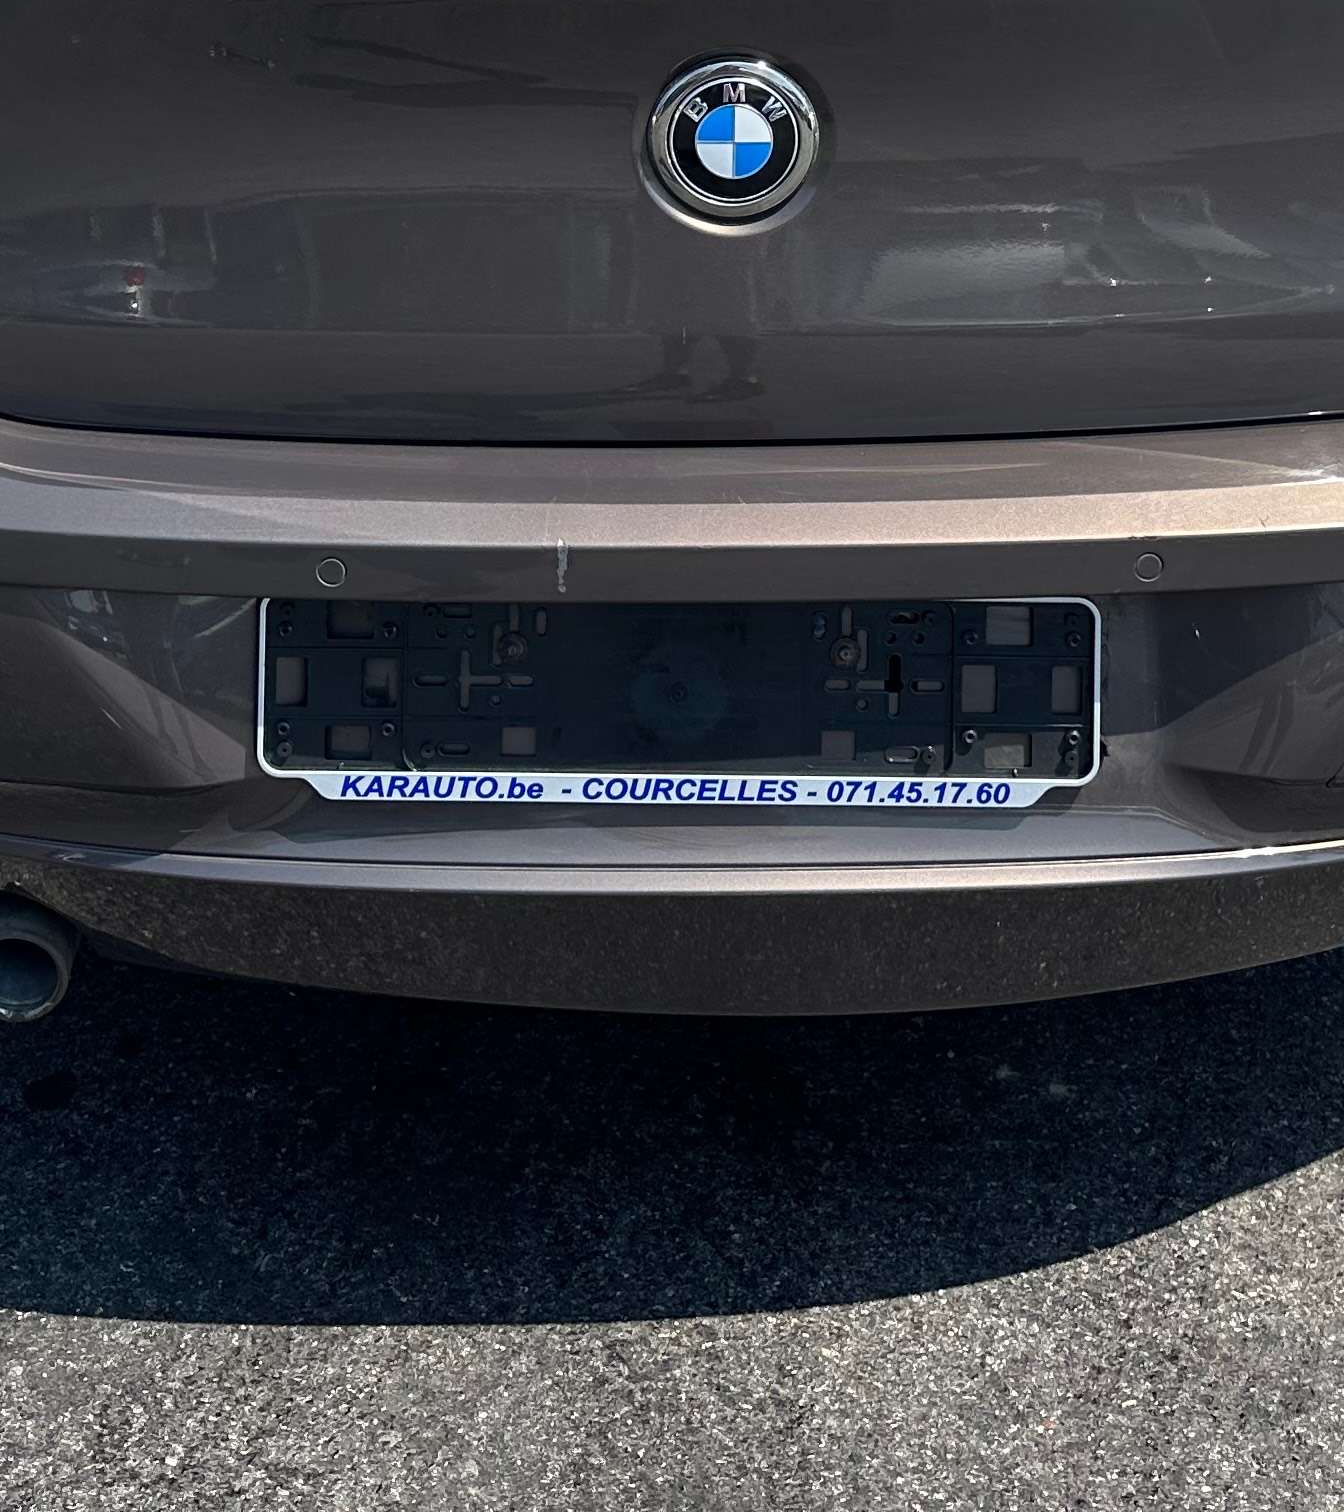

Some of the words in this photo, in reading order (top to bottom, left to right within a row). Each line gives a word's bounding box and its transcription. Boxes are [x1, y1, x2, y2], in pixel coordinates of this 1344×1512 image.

[683, 82, 788, 123] BMW
[340, 775, 544, 800] KARAUTO.be
[582, 776, 799, 802] COURCELLES
[826, 781, 1011, 805] 071.45.17.60
